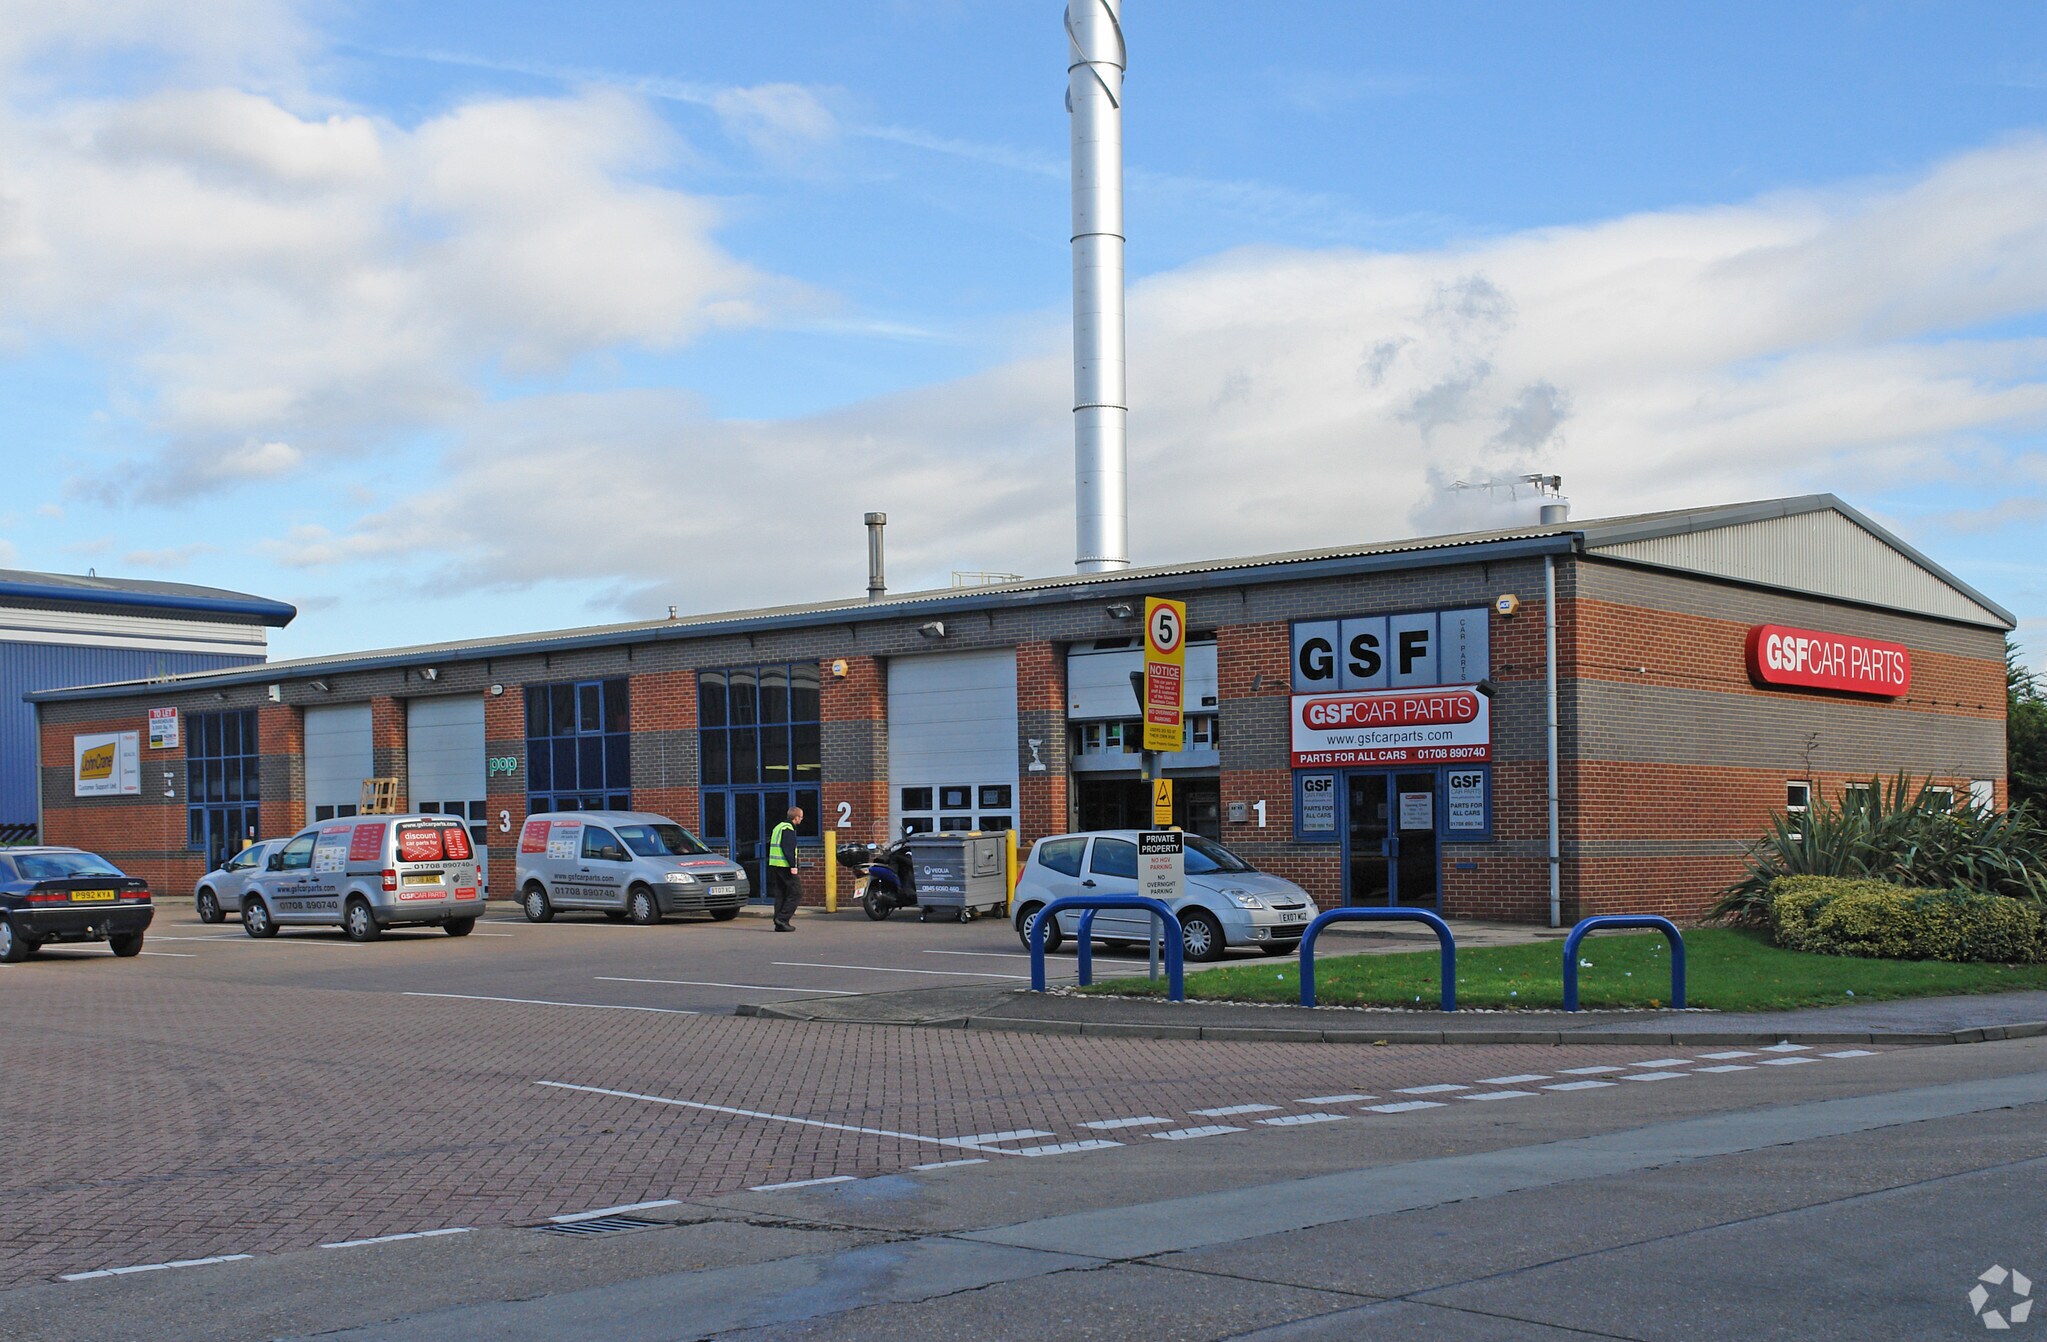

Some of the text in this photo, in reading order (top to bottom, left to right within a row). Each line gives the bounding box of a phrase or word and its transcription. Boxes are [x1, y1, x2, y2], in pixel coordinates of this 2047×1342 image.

[1159, 614, 1173, 644] 5
[1299, 630, 1429, 680] GSF
[1149, 664, 1180, 677] NOTICE
[1851, 646, 1905, 685] PARTS
[163, 709, 173, 717] LET
[1404, 697, 1471, 720] PARTS
[1327, 730, 1453, 747] www.gsfcarparts.com
[1300, 747, 1486, 763] PARTS FOR ALL CARS 01708 890740
[490, 756, 517, 777] pop
[1304, 779, 1332, 792] GSF
[1451, 775, 1481, 788] GSF
[837, 801, 851, 827] 2
[1253, 800, 1266, 827] 1
[500, 810, 511, 832] 3
[404, 832, 437, 840] discount
[1146, 834, 1175, 843] PRIVATE
[1141, 844, 1180, 854] PROPERTY
[554, 873, 614, 882] www.gsfcarparts.com
[277, 885, 335, 894] www.gsfcarparts.com
[555, 887, 615, 897] 01708 890740
[280, 901, 337, 909] 01708 890740
[1282, 913, 1297, 921] EX07
